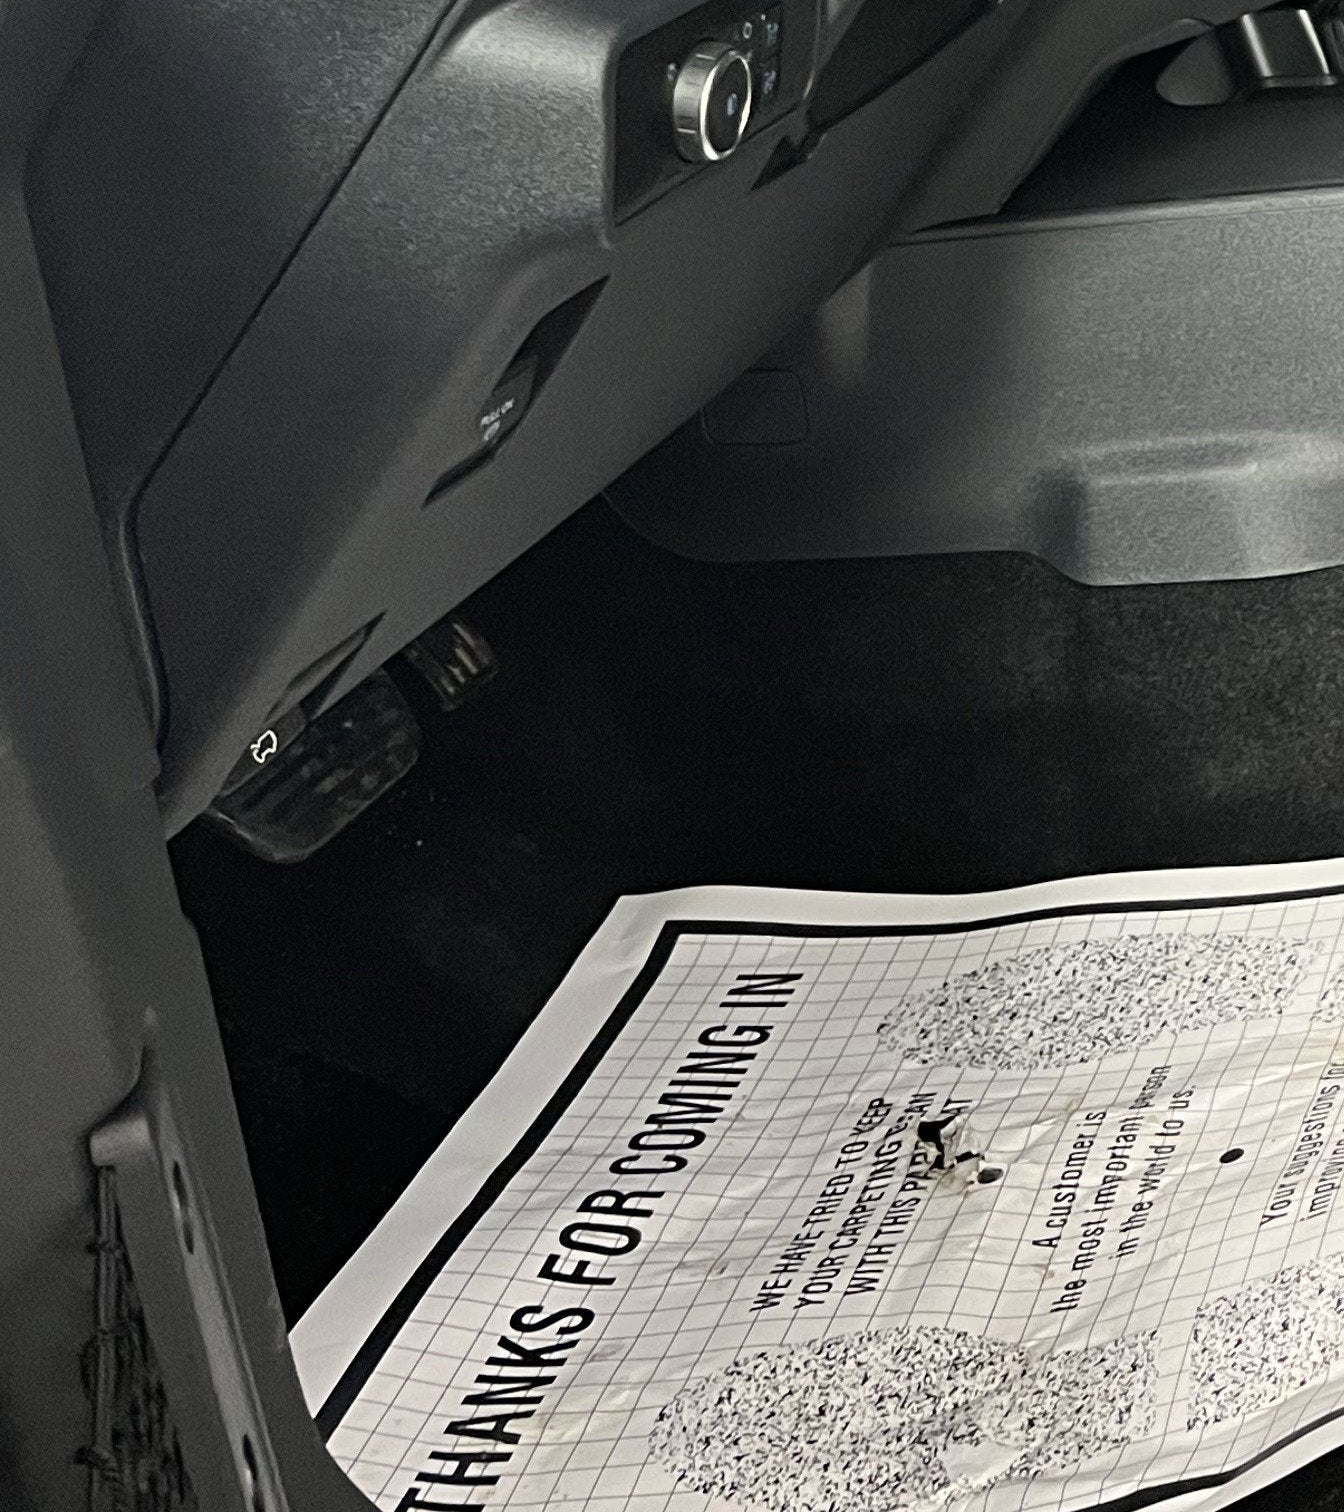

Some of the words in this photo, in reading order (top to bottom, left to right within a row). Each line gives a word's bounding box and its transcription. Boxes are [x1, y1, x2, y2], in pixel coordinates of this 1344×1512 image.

[850, 1097, 893, 1136] KEEP
[1076, 1110, 1108, 1128] is
[1155, 1118, 1184, 1137] to
[835, 1141, 869, 1171] TO
[1084, 1115, 1144, 1214] important
[1138, 1144, 1176, 1195] world
[1259, 1181, 1298, 1227] Your
[1283, 1085, 1340, 1178] suggestions
[802, 1173, 855, 1229] TRIED
[1046, 1130, 1094, 1229] customer
[793, 1251, 851, 1309] YOUR
[828, 1140, 903, 1251] CARPETING
[1119, 1201, 1153, 1233] the
[394, 1305, 595, 1512] THANKS
[537, 1189, 665, 1285] FOR
[609, 1025, 774, 1174] COMING
[719, 973, 804, 1007] IN
[770, 1231, 824, 1274] HAVE
[844, 1242, 898, 1297] WITH
[873, 1197, 922, 1239] THIS
[1032, 1234, 1061, 1249] A
[1072, 1217, 1108, 1271] most
[1108, 1237, 1139, 1260] in
[749, 1279, 792, 1312] WE
[1050, 1279, 1086, 1313] the
